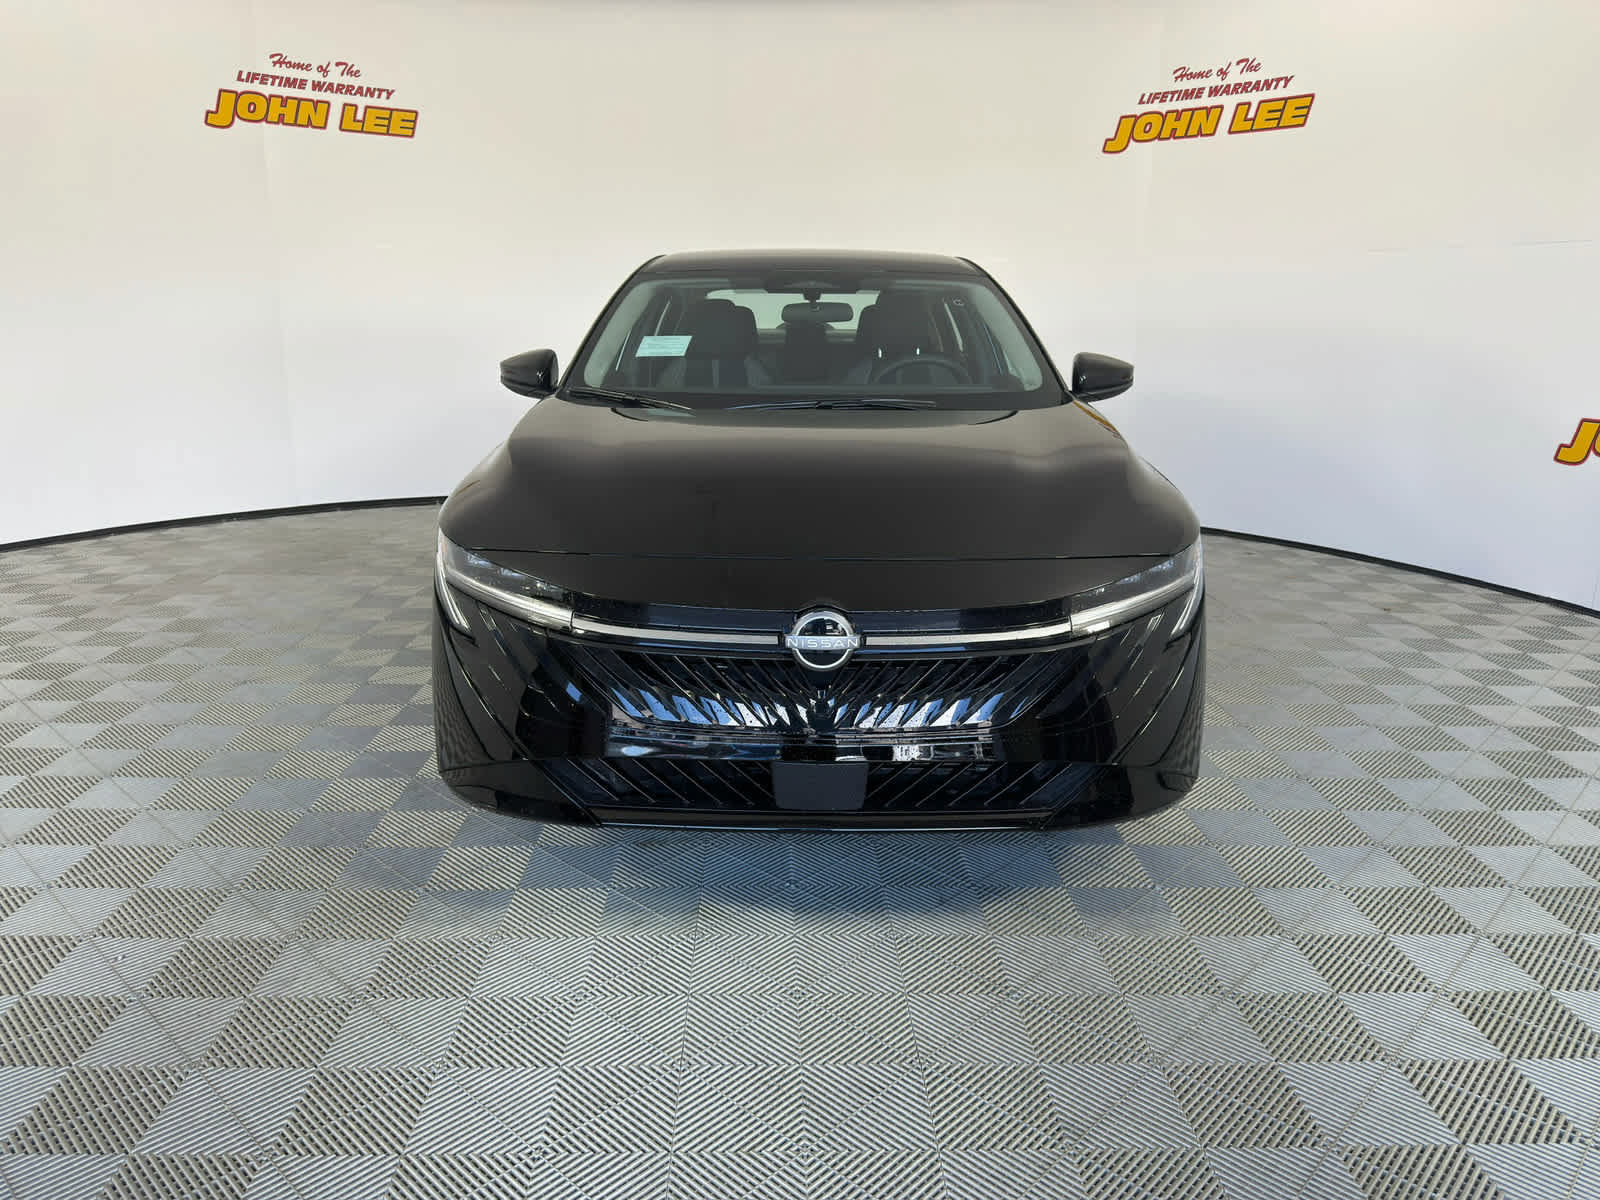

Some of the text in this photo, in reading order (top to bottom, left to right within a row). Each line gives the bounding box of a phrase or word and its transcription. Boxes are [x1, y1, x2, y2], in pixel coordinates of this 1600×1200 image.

[269, 53, 361, 78] Home of The
[1173, 57, 1262, 82] Home of The
[236, 70, 395, 100] LIFETIME WARRANTY
[1138, 75, 1295, 105] LIFETIME WARRANTY
[204, 88, 419, 138] JOHN LEE
[1102, 93, 1315, 154] JOHN LEE
[786, 638, 858, 648] NISSAN
